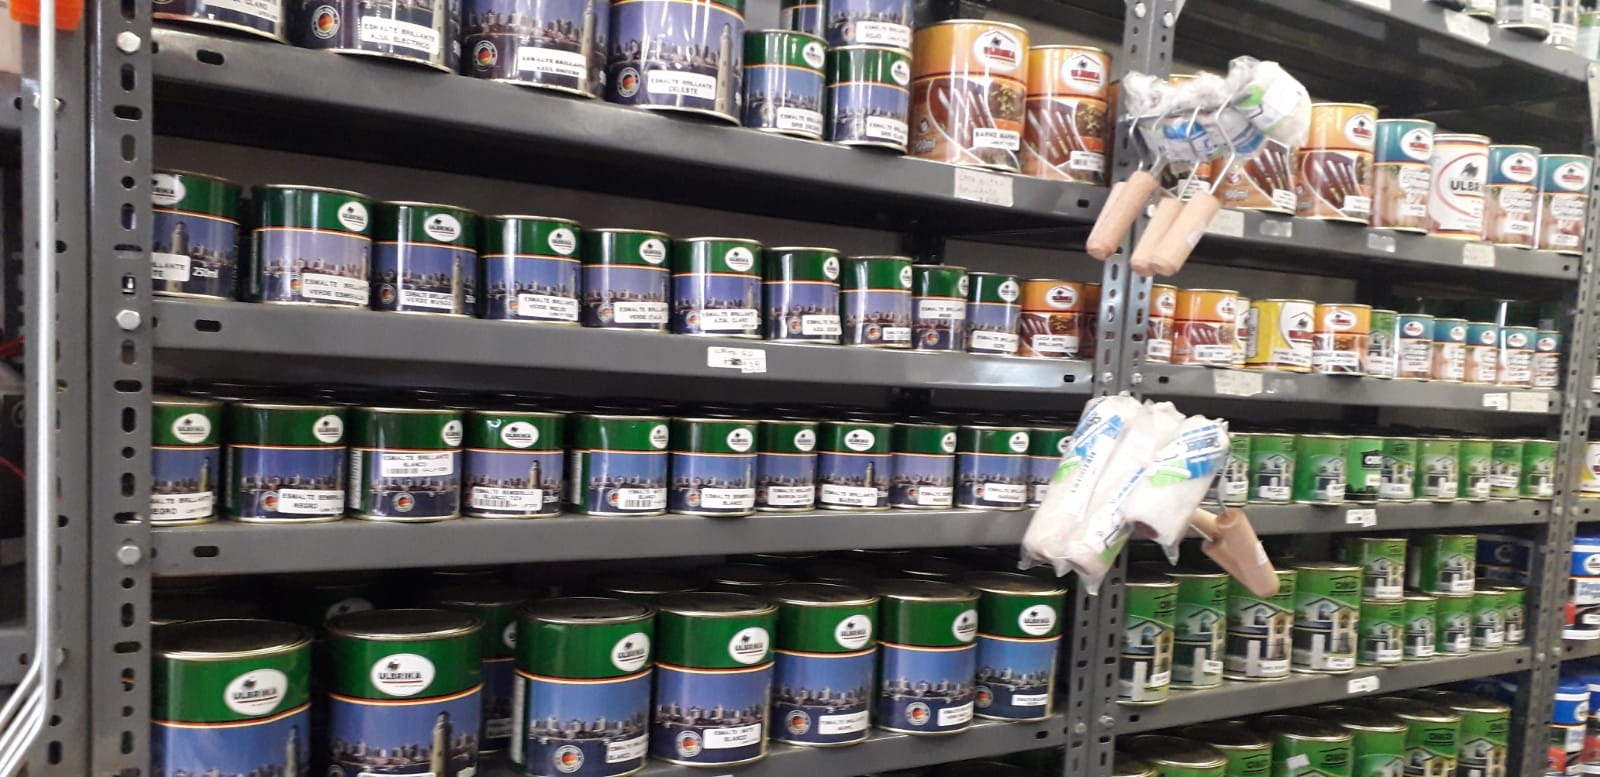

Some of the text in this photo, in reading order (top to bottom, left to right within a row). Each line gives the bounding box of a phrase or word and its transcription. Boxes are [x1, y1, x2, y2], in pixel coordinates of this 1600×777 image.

[363, 22, 436, 41] ESMALTE BRILLANTE
[393, 35, 431, 49] ELECTRICO
[681, 79, 713, 90] BRILLANTE
[669, 86, 698, 96] CELESTE
[191, 266, 219, 279] 250ml
[304, 278, 338, 287] ESMALTE
[309, 289, 332, 297] VERDE
[282, 492, 315, 501] ESMALTE
[378, 671, 422, 680] ULBRIKA
[233, 687, 278, 701] ULBRIKA
